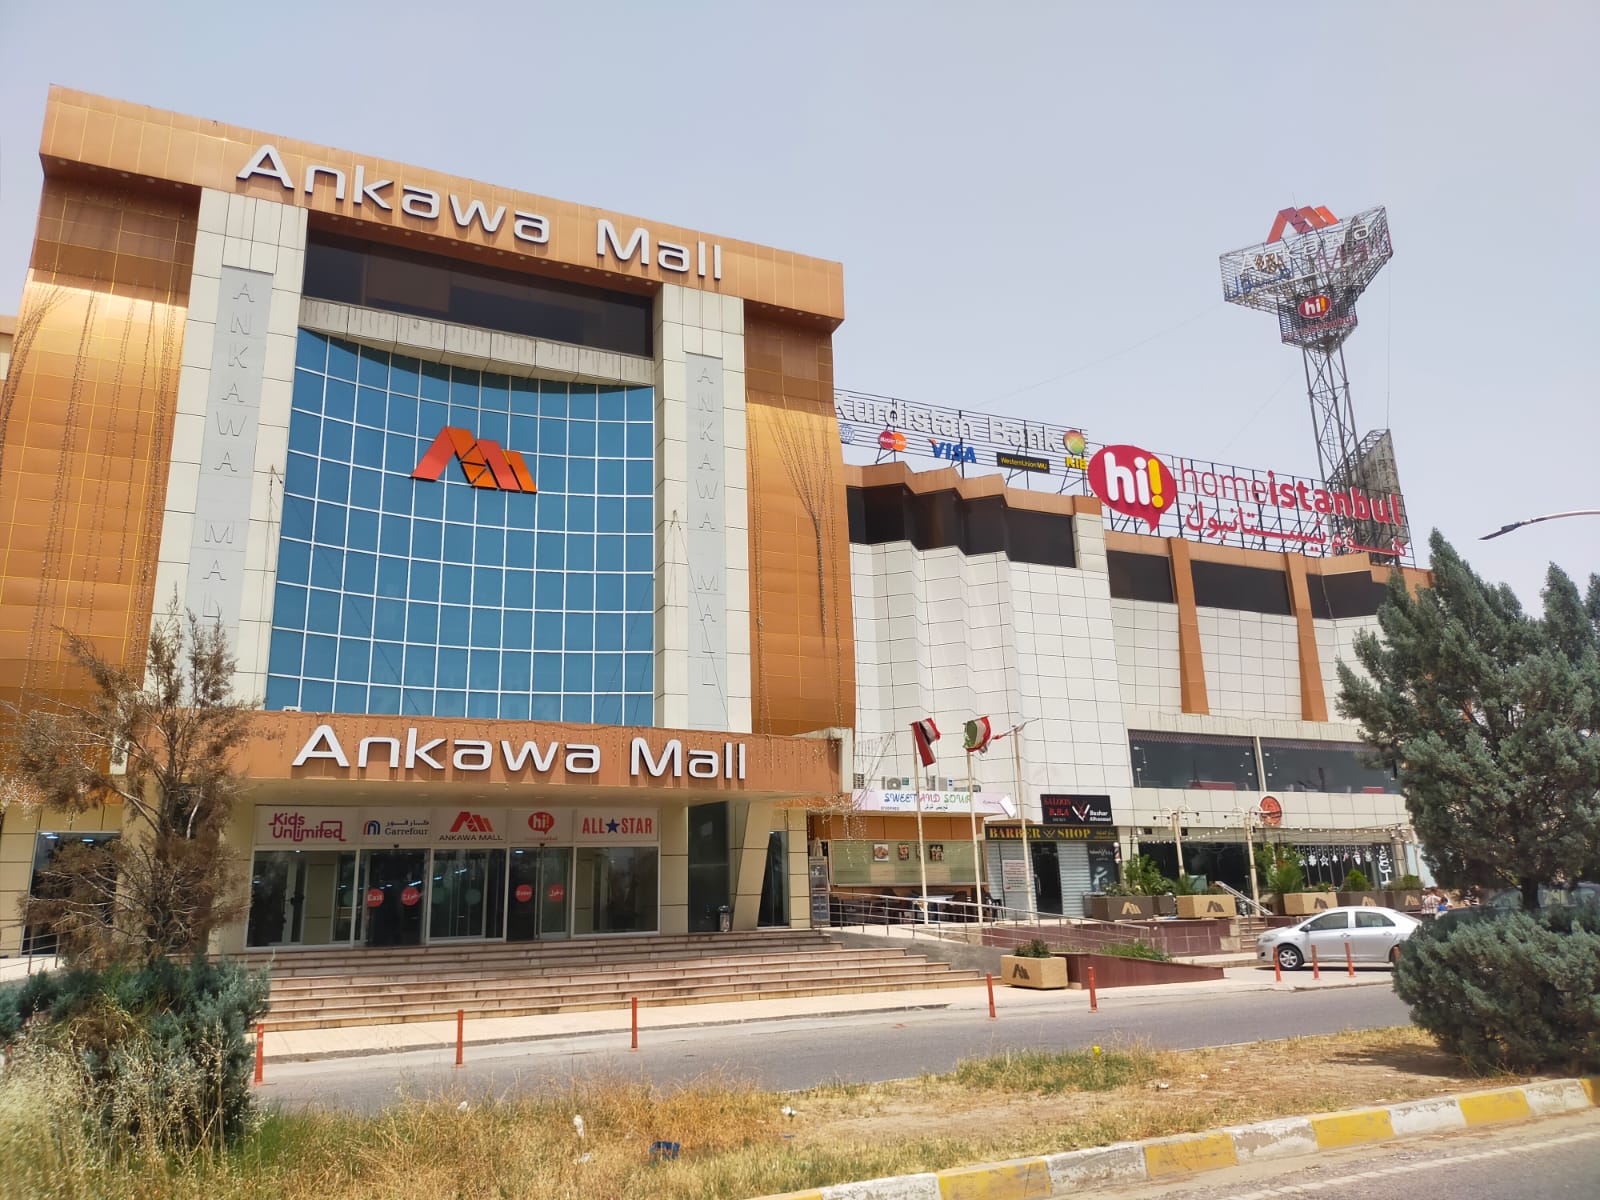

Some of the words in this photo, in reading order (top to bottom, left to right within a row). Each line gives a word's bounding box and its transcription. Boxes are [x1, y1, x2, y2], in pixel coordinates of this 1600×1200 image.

[236, 143, 551, 245] Ankawa
[595, 217, 722, 281] Mall
[1304, 297, 1326, 315] hi!
[214, 282, 255, 473] ANKAWA
[988, 415, 1056, 451] Bank
[696, 367, 718, 530] ANKAWA
[928, 438, 977, 464] VISA
[1103, 451, 1163, 508] hi!
[202, 520, 236, 656] MAL
[291, 723, 601, 775] Ankawa
[629, 736, 747, 780] Mall
[269, 813, 305, 826] Kids
[272, 820, 347, 841] Unlimited
[532, 814, 550, 828] hi!
[582, 817, 605, 834] ALL
[621, 818, 653, 834] STAR
[384, 827, 429, 836] Carrefour
[438, 834, 477, 842] ANKAWA
[1058, 828, 1091, 839] SHOP
